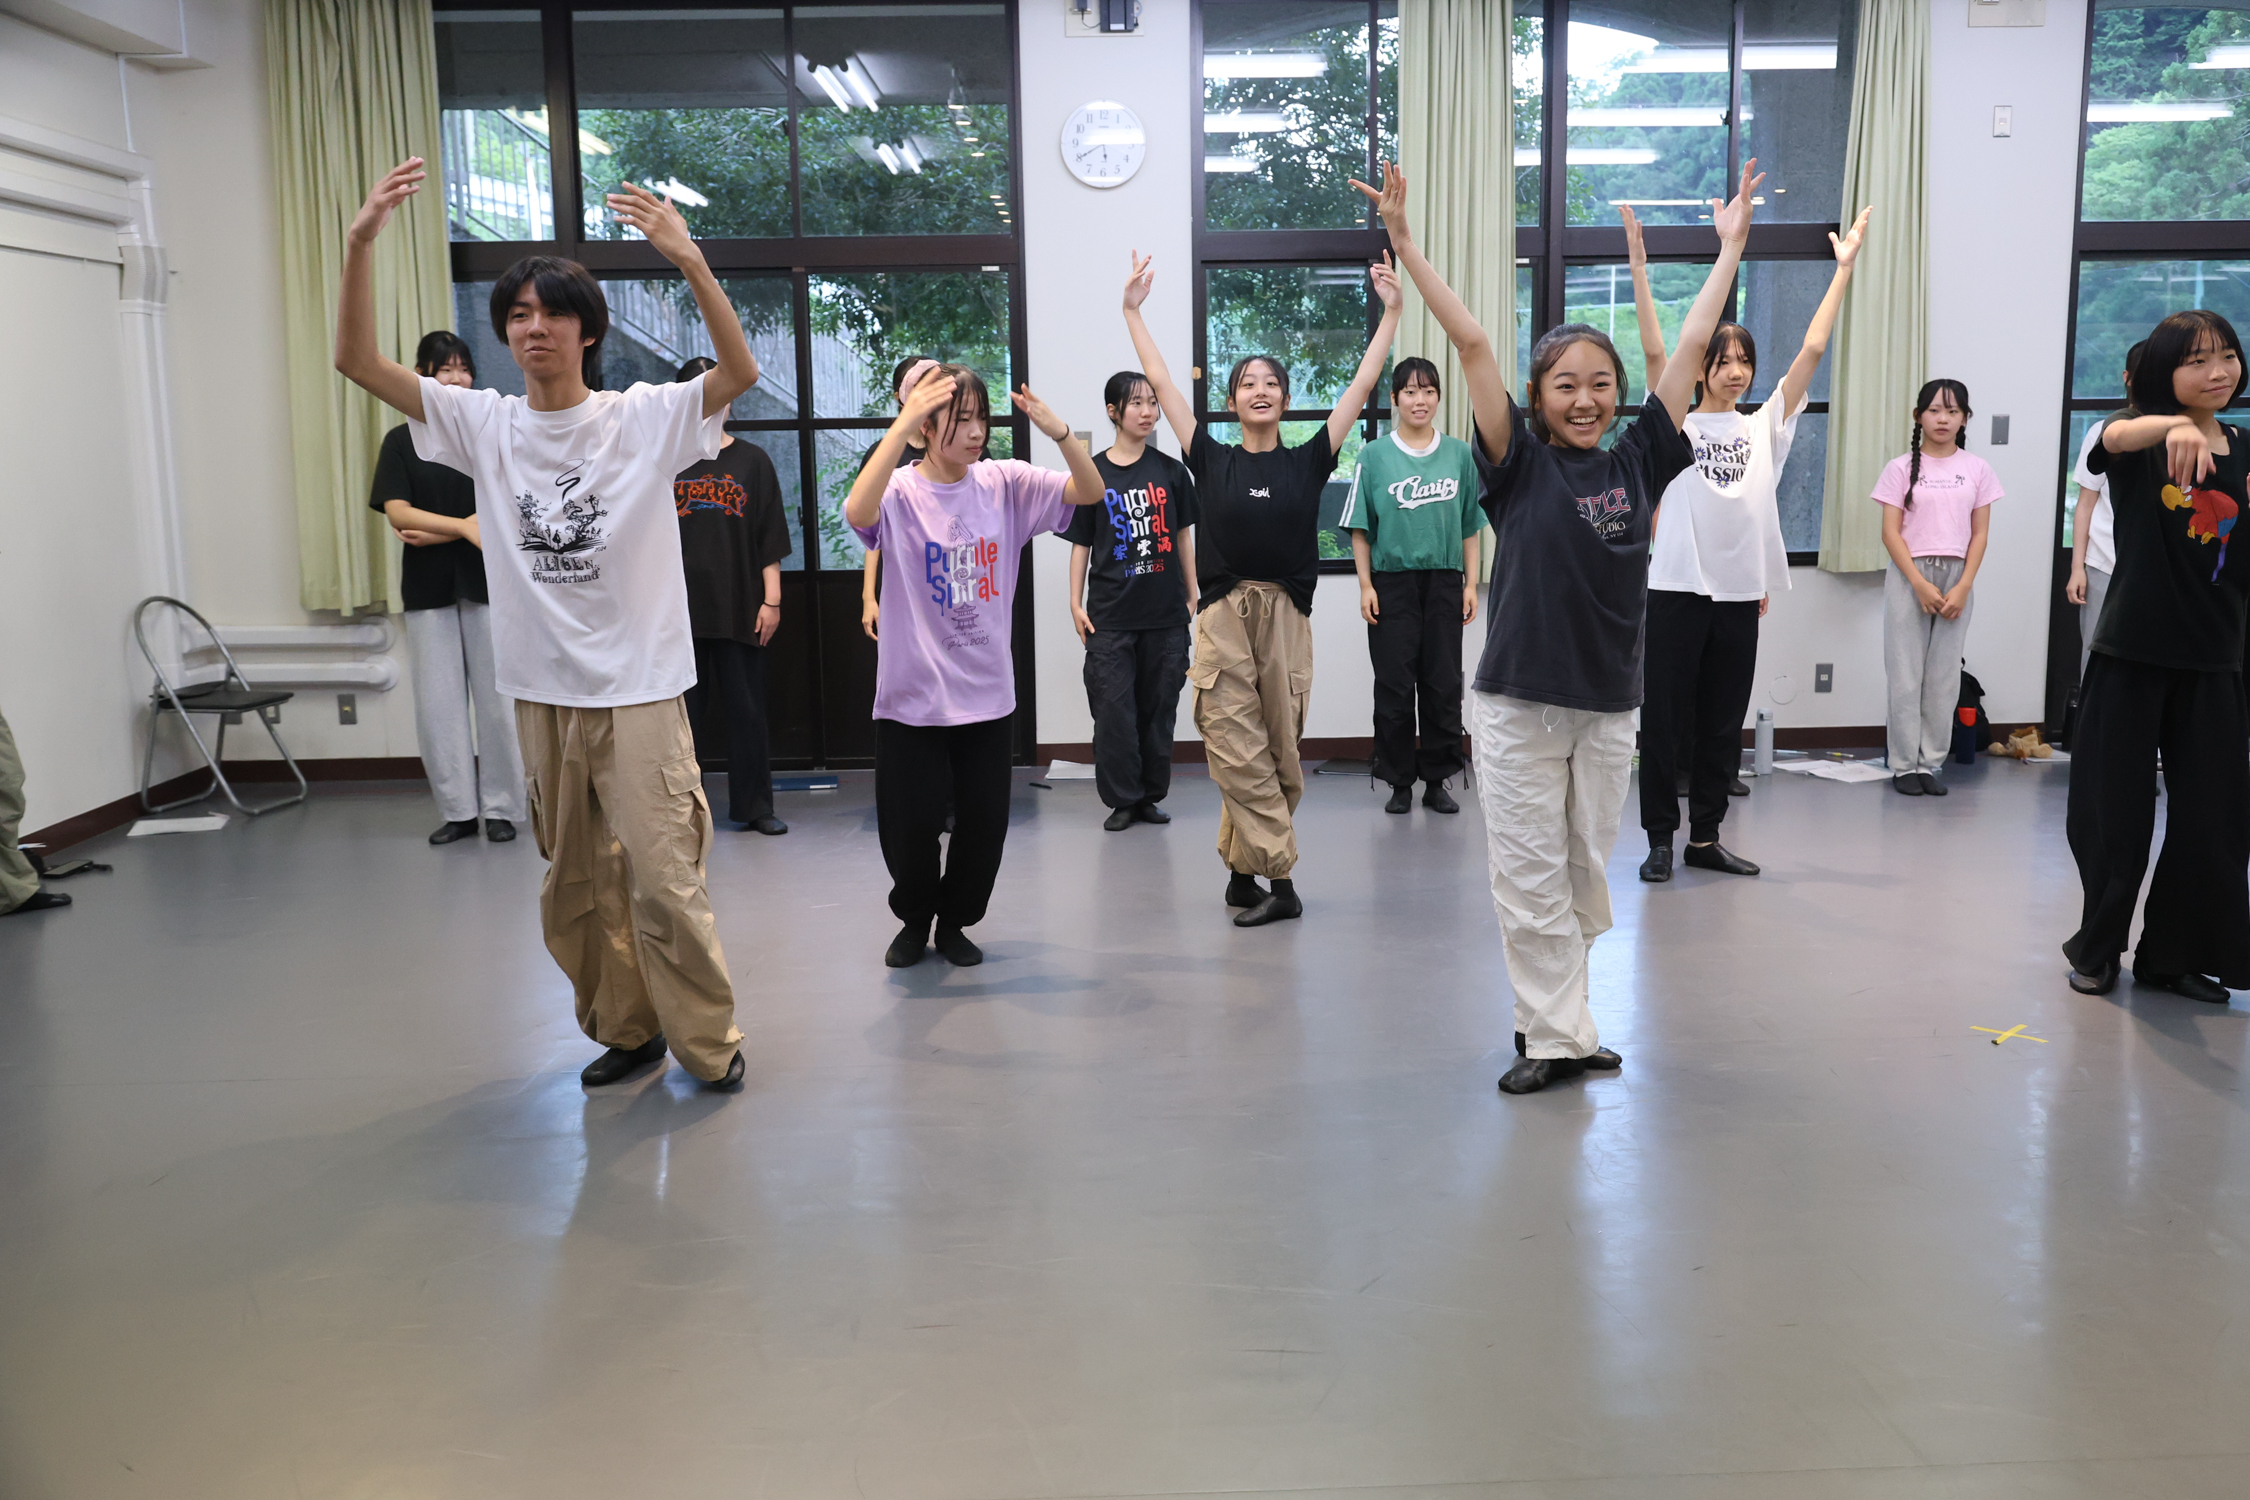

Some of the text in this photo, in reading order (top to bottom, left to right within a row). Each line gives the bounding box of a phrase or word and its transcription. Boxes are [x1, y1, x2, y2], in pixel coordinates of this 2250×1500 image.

[1086, 113, 1093, 124] 11
[1100, 109, 1109, 120] 12
[1076, 124, 1085, 134] 10
[1072, 138, 1079, 148] 9
[1076, 152, 1083, 163] 8
[1123, 154, 1129, 163] 4
[1086, 164, 1092, 174] 7
[1100, 167, 1107, 178] 6
[1114, 164, 1120, 174] 5
[1387, 475, 1459, 505] Clarify
[1104, 482, 1168, 525] Purple
[1113, 504, 1170, 542] Spiral
[925, 536, 998, 583] Purple
[1146, 563, 1165, 574] 2025
[931, 564, 999, 609] Spiral
[969, 635, 989, 646] 2025
